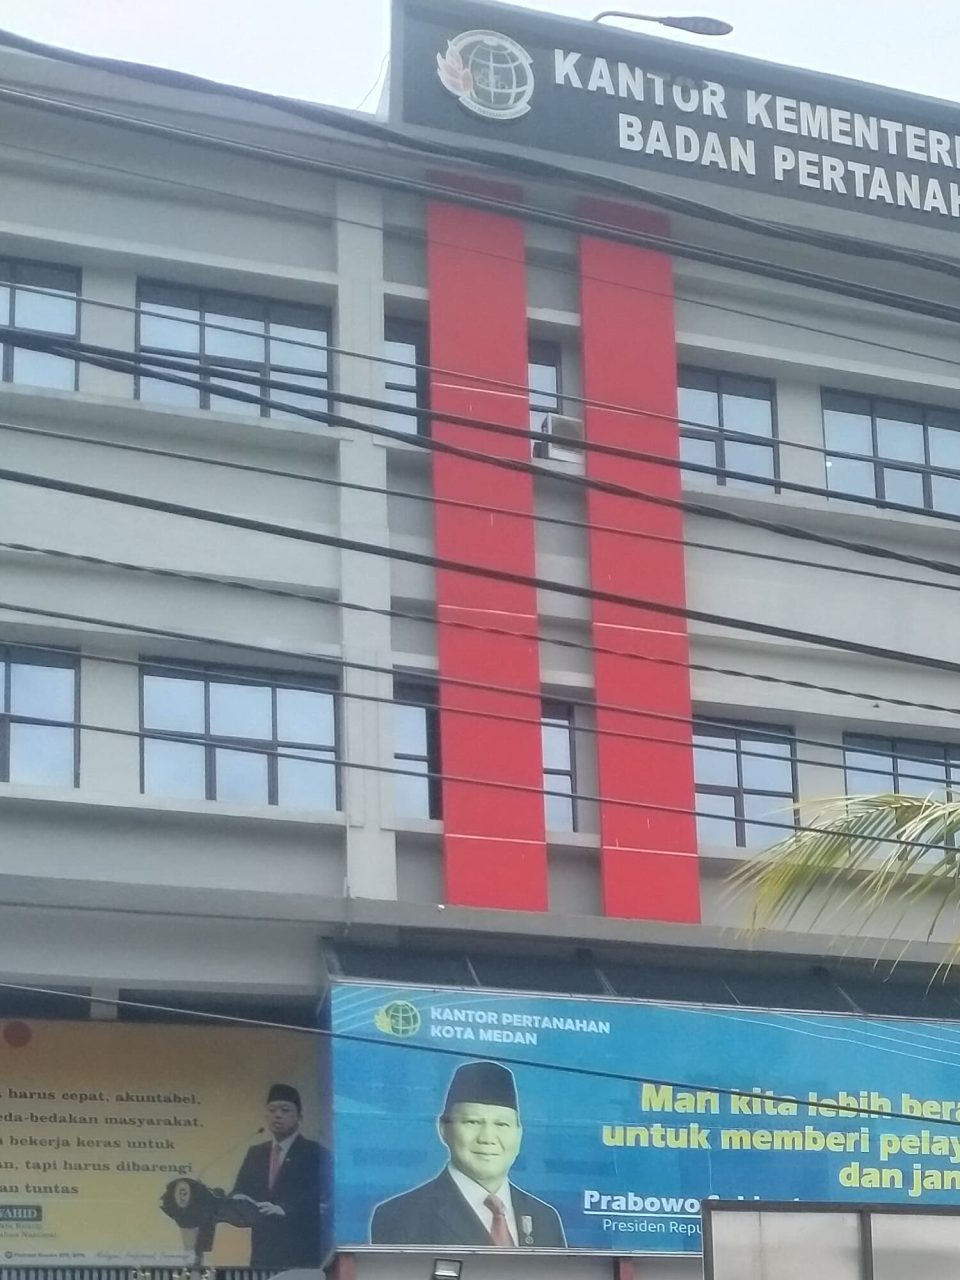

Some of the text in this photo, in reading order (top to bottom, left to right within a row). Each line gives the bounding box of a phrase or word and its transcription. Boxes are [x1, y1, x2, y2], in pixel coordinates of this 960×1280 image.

[554, 48, 728, 120] KANTOR
[618, 112, 757, 177] BADAN
[430, 1006, 611, 1035] KANTOR PERTANAHAN
[430, 1024, 538, 1046] KOTA MEDAN
[7, 1088, 57, 1100] harus
[61, 1091, 110, 1104] cepat,
[641, 1083, 721, 1116] Mari
[730, 1087, 798, 1117] kita
[807, 1090, 893, 1120] lebih
[0, 1111, 99, 1124] da-bedakan
[9, 1135, 176, 1150] bekerja keras untuk
[602, 1123, 712, 1149] untuk
[720, 1126, 870, 1153] memberi
[25, 1160, 57, 1173] tapi
[63, 1160, 111, 1172] harus
[116, 1161, 193, 1175] dibarengi
[838, 1161, 904, 1189] dan
[25, 1183, 80, 1195] tuntas
[584, 1189, 701, 1213] Prabowo
[603, 1218, 702, 1236] Presiden Repu
